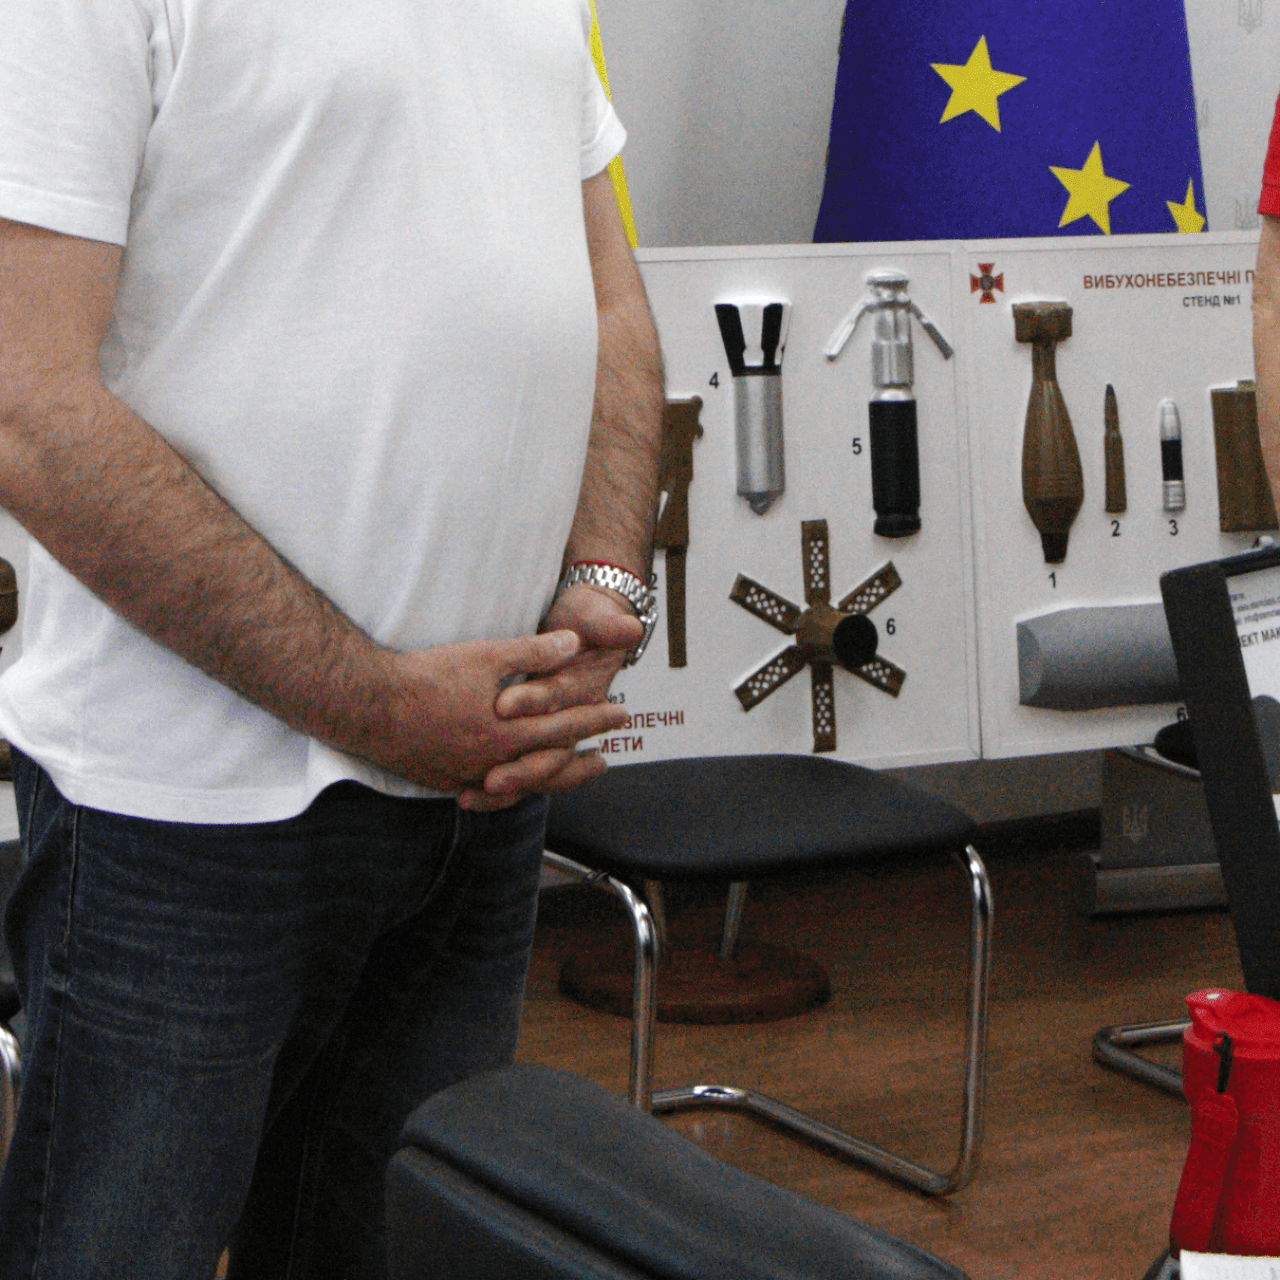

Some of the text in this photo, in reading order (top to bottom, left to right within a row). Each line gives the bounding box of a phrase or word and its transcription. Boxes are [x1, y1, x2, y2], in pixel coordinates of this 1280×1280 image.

[1083, 270, 1241, 289] ВИБУХОНЕБЕЗПЕЧНІ
[1183, 294, 1241, 308] СТЕНД №1
[709, 372, 719, 389] 4
[852, 437, 862, 455] 5
[1111, 520, 1121, 537] 2
[1169, 520, 1179, 536] 3
[1049, 571, 1057, 588] 1
[886, 618, 896, 636] 6
[1240, 631, 1259, 648] ЕКТ
